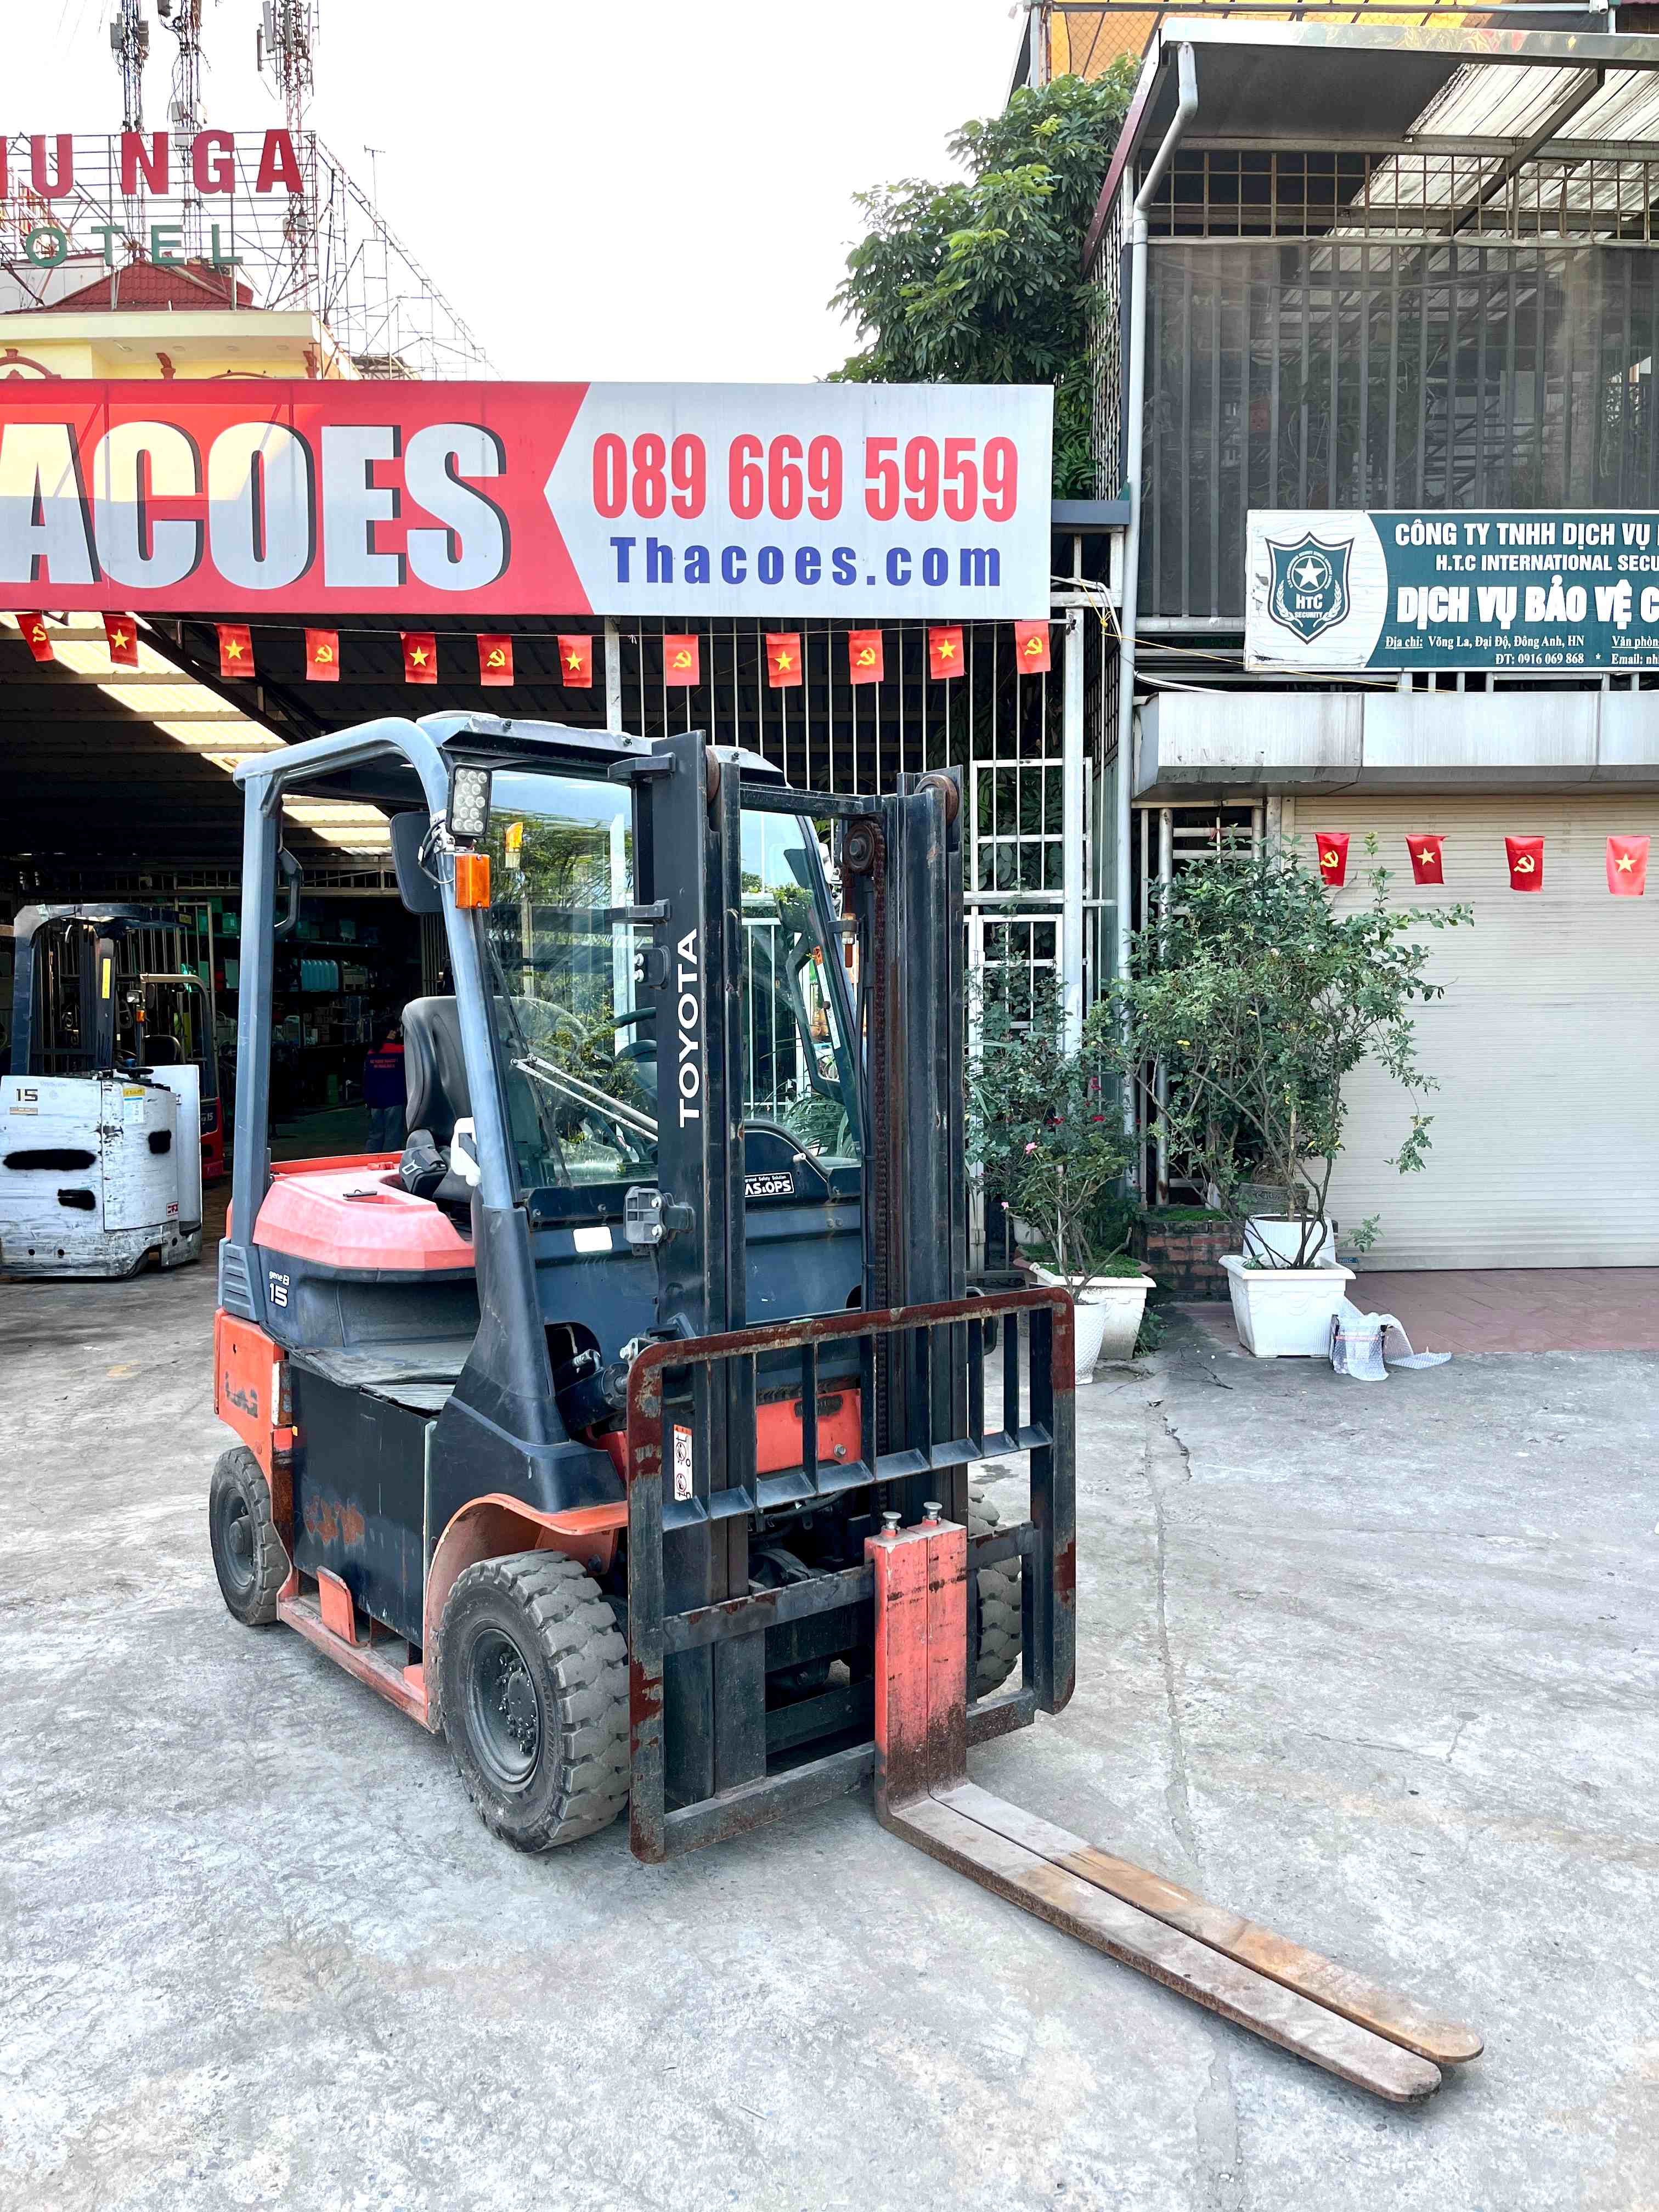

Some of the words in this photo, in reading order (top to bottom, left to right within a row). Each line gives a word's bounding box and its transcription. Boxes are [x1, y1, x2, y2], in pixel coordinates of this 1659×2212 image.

[121, 129, 304, 194] NGA
[25, 224, 243, 267] OTEL
[593, 433, 707, 519] 089
[729, 434, 843, 521] 669
[865, 436, 1018, 522] 5959
[0, 421, 512, 591] ACOES
[1395, 519, 1457, 546] CÔNG
[1464, 522, 1490, 545] TY
[1496, 522, 1555, 545] TNHH
[1562, 522, 1615, 550] DỊCH
[1622, 522, 1650, 550] VỤ
[610, 537, 1001, 586] Thacoes.com
[1436, 555, 1476, 571] H.T.C
[1481, 555, 1612, 571] INTERNATIONAL
[1296, 594, 1323, 609] HTC
[1397, 586, 1470, 630] DỊCH
[1476, 586, 1517, 630] VỤ
[1525, 574, 1587, 622] BẢO
[1594, 579, 1633, 630] VỆ
[1385, 636, 1402, 649] Địa
[1428, 636, 1454, 649] Võng
[1457, 636, 1472, 649] La,
[1475, 636, 1492, 649] Đại
[1495, 635, 1511, 649] Độ,
[1514, 635, 1539, 649] Đông
[1542, 635, 1565, 648] Anh,
[1567, 635, 1584, 646] HN
[1612, 635, 1632, 646] Văn
[1634, 635, 1659, 650] phòn
[1496, 653, 1515, 664] ĐT:
[1518, 653, 1542, 664] 0916
[1545, 653, 1563, 664] 069
[1566, 653, 1584, 664] 868
[1611, 653, 1643, 664] Email:
[1646, 653, 1659, 664] nh
[678, 928, 699, 1128] TOYOTA
[16, 1088, 38, 1101] 15
[269, 1283, 288, 1308] 15
